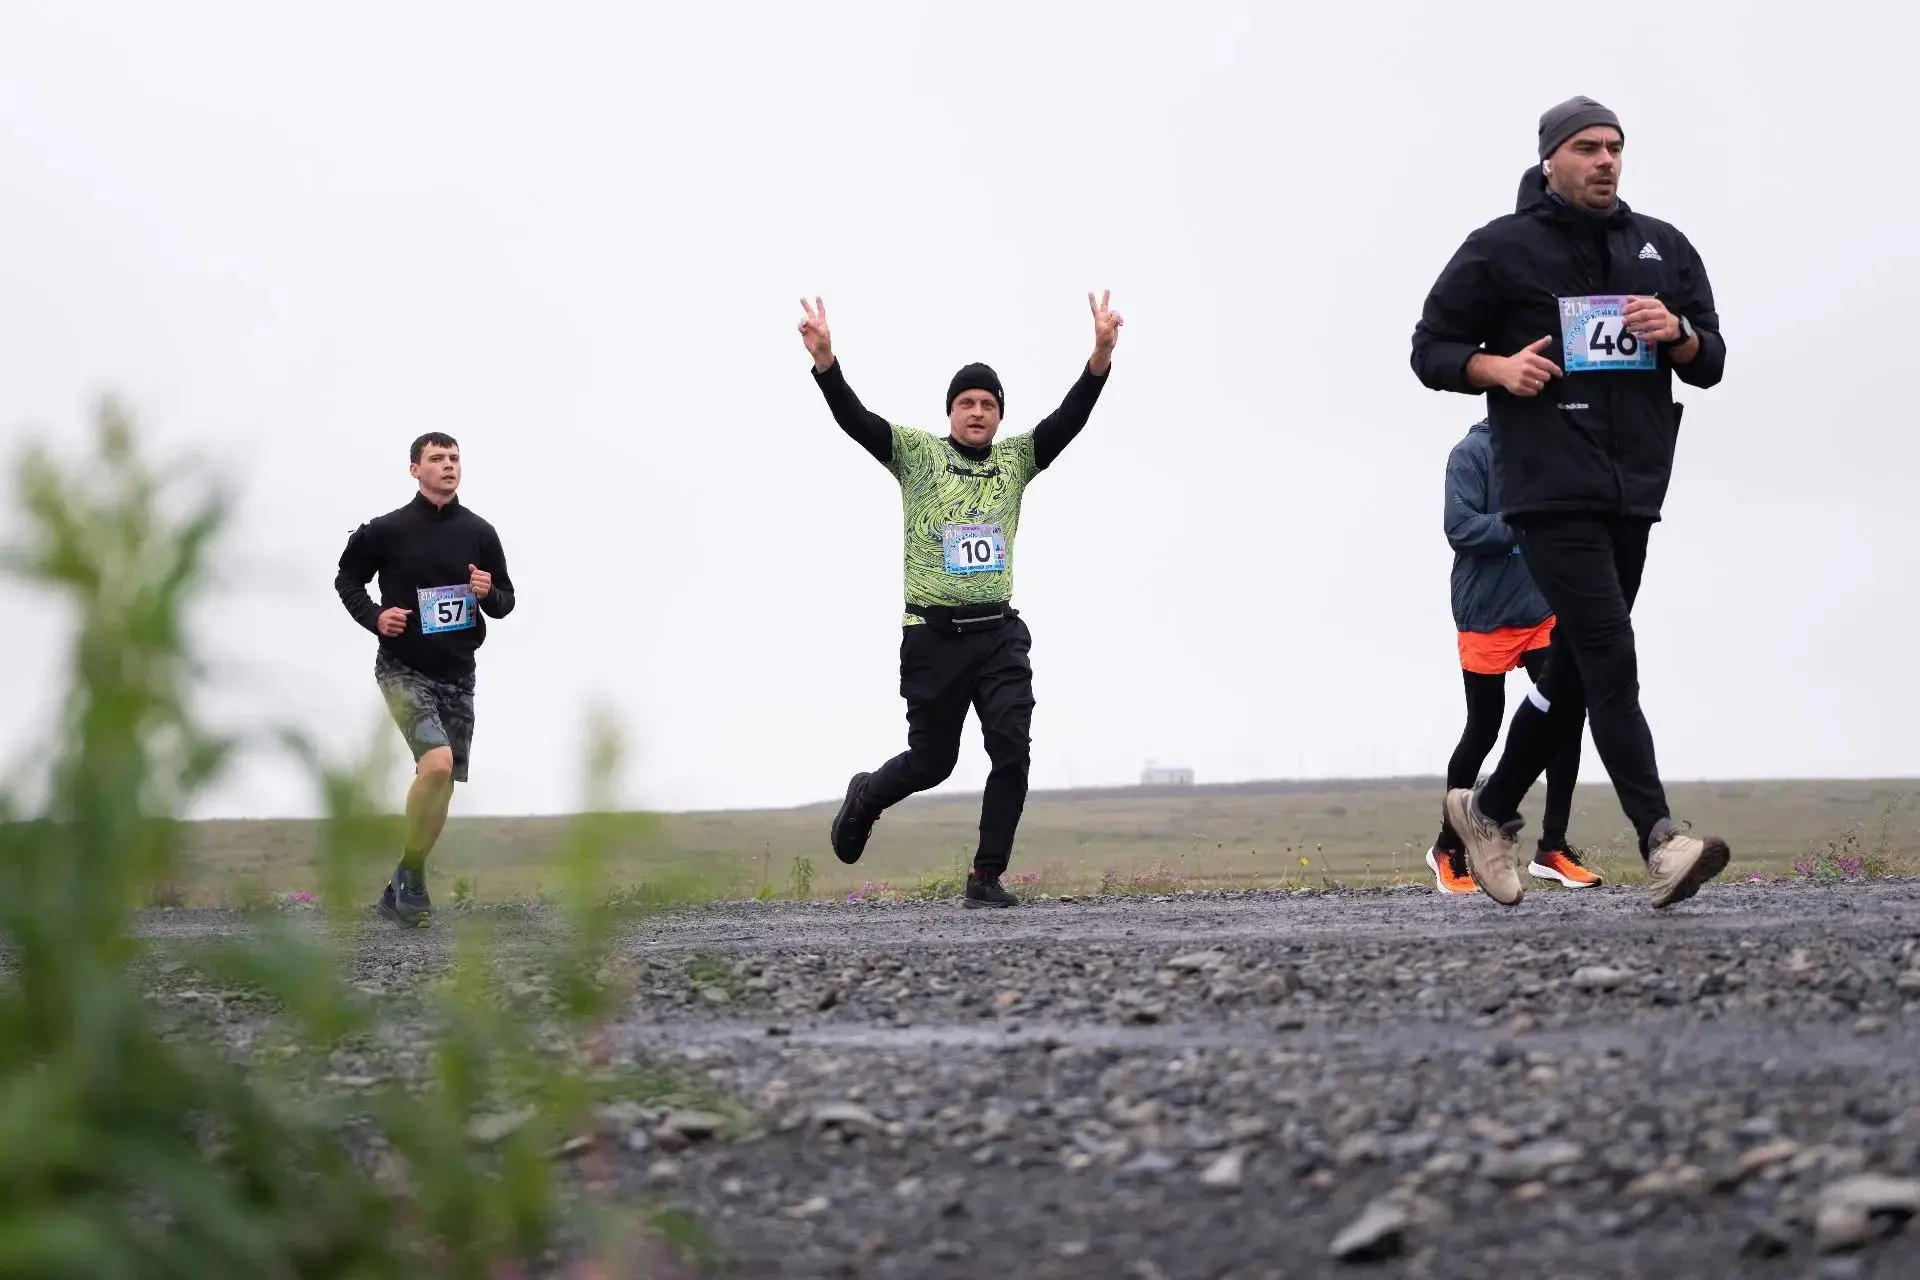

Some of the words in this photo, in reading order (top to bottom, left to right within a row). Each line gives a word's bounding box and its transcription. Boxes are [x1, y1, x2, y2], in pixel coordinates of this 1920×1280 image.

[1589, 321, 1638, 356] 46
[961, 539, 991, 564] 10
[438, 599, 464, 624] 57
